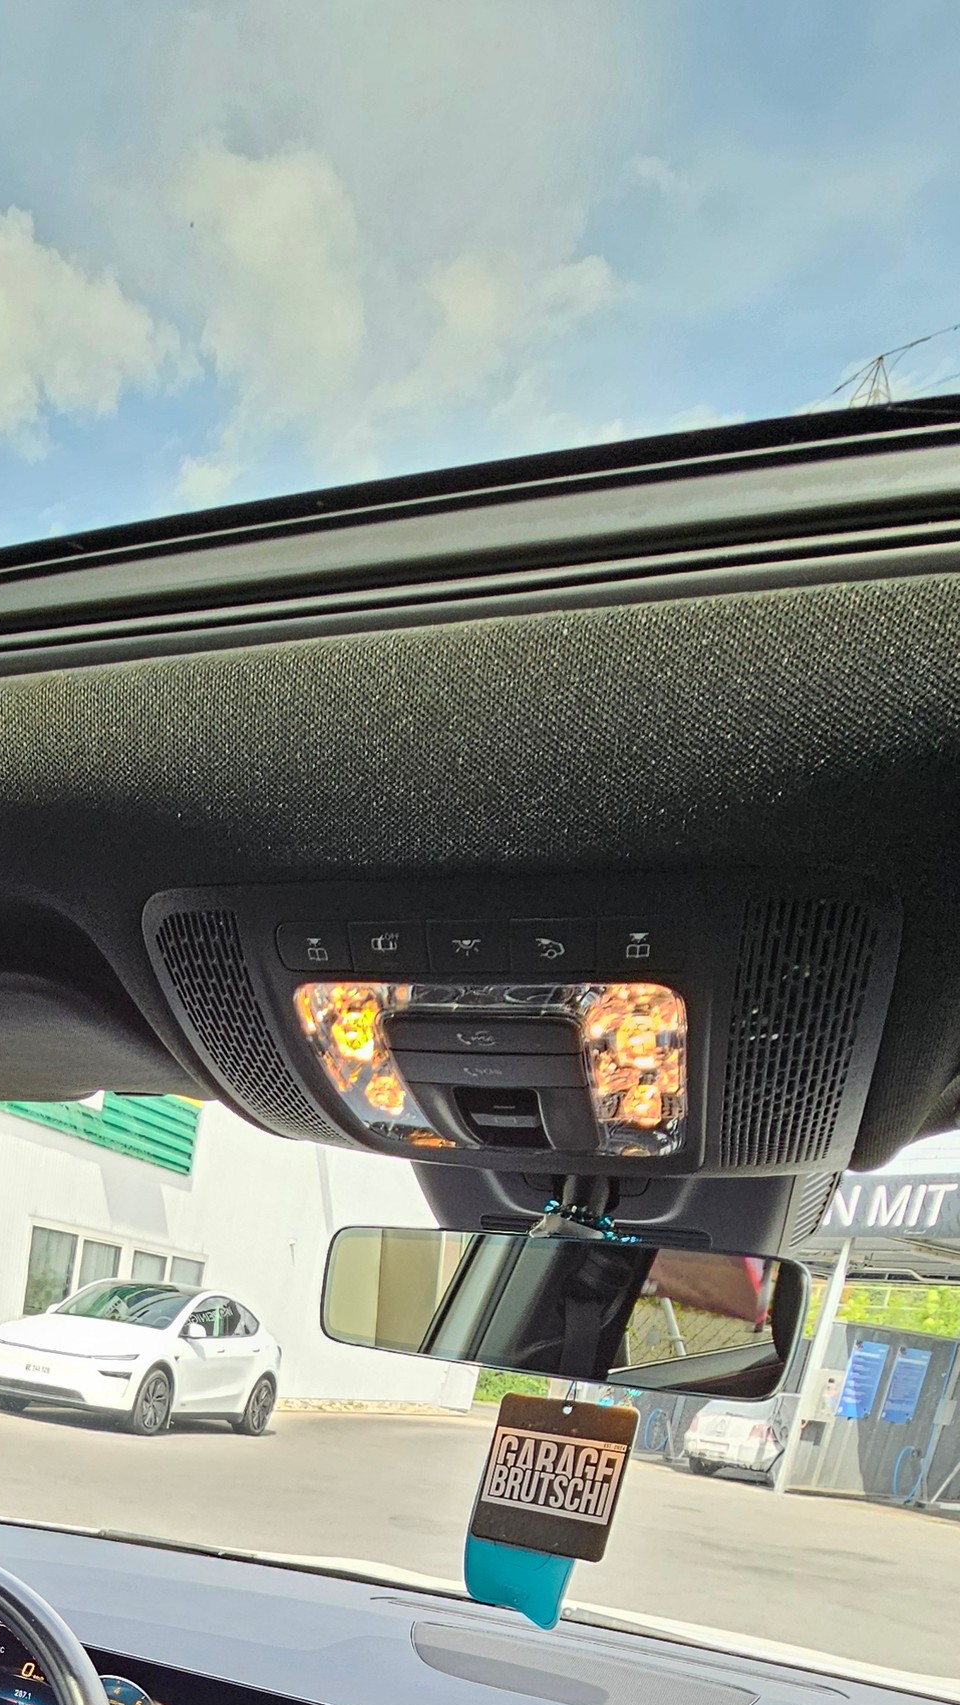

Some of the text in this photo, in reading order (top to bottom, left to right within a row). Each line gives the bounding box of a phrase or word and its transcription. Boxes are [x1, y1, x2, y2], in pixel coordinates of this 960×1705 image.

[866, 1183, 959, 1227] MIT
[496, 1435, 615, 1482] GARAGE
[489, 1463, 610, 1517] BRUTSCHI
[21, 1662, 35, 1678] 0
